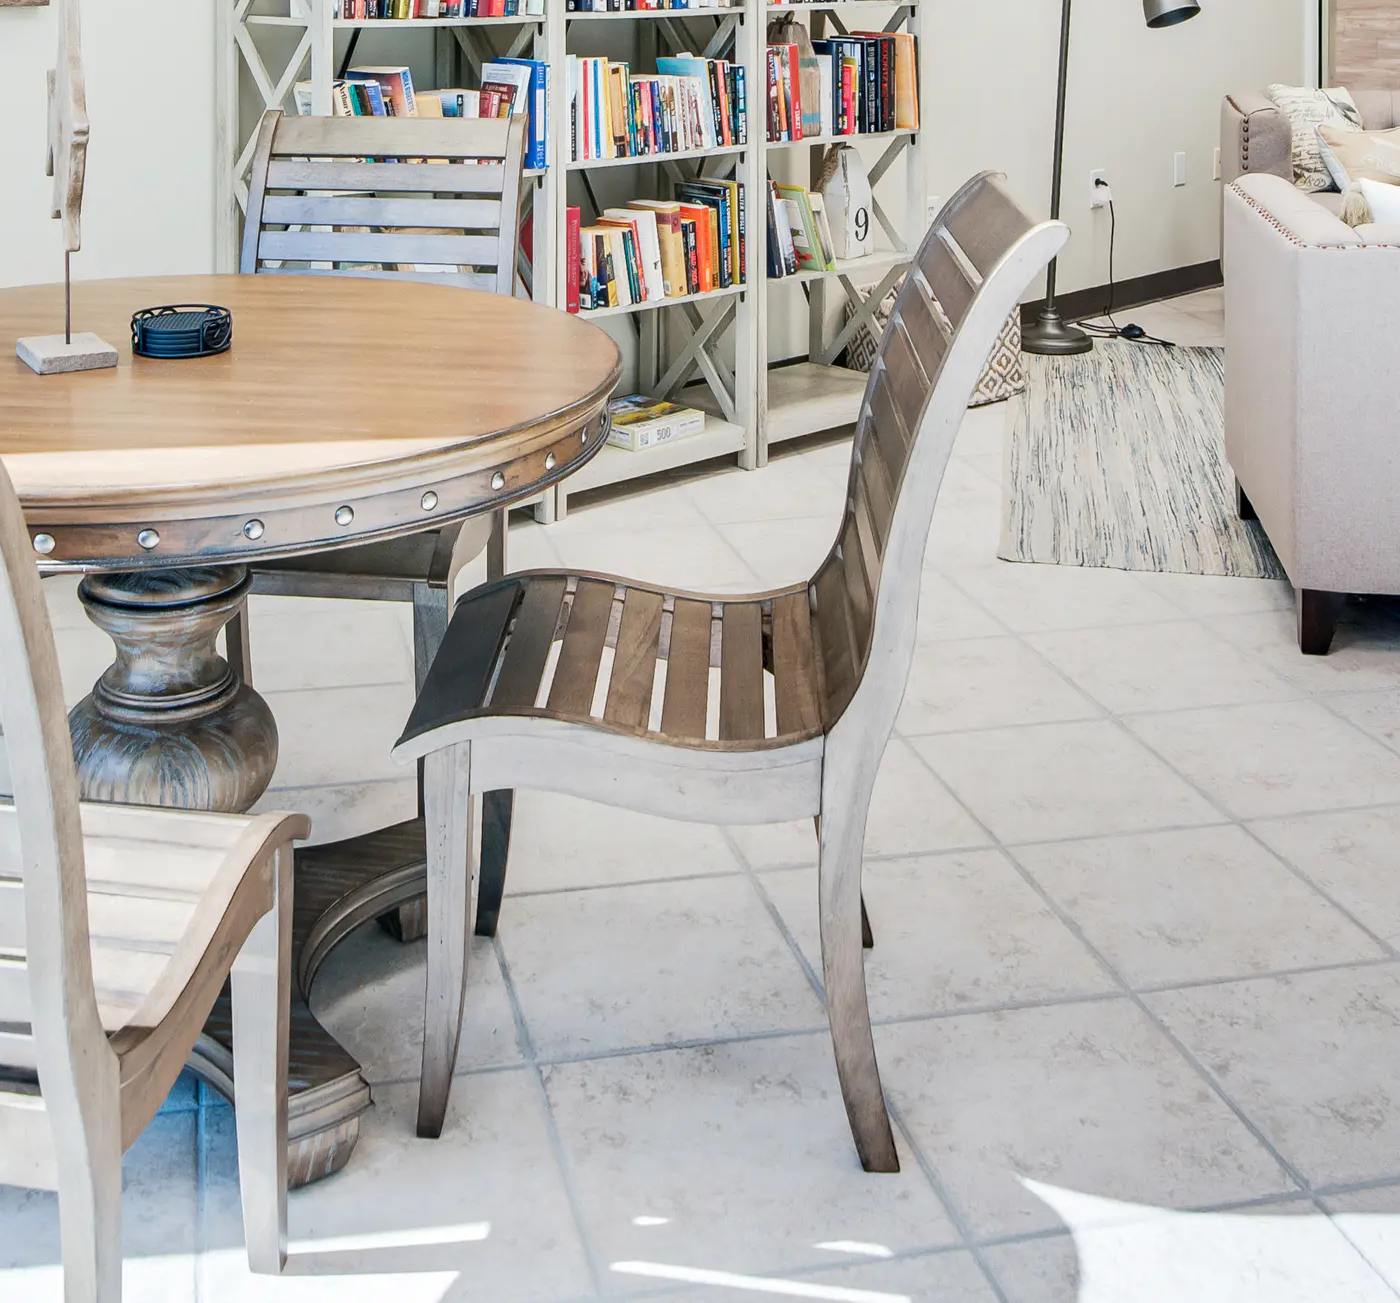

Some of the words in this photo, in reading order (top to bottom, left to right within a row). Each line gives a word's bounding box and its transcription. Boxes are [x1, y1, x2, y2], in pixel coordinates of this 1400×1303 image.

[340, 85, 349, 110] Arthur
[855, 207, 869, 242] 9
[656, 426, 671, 441] 500
